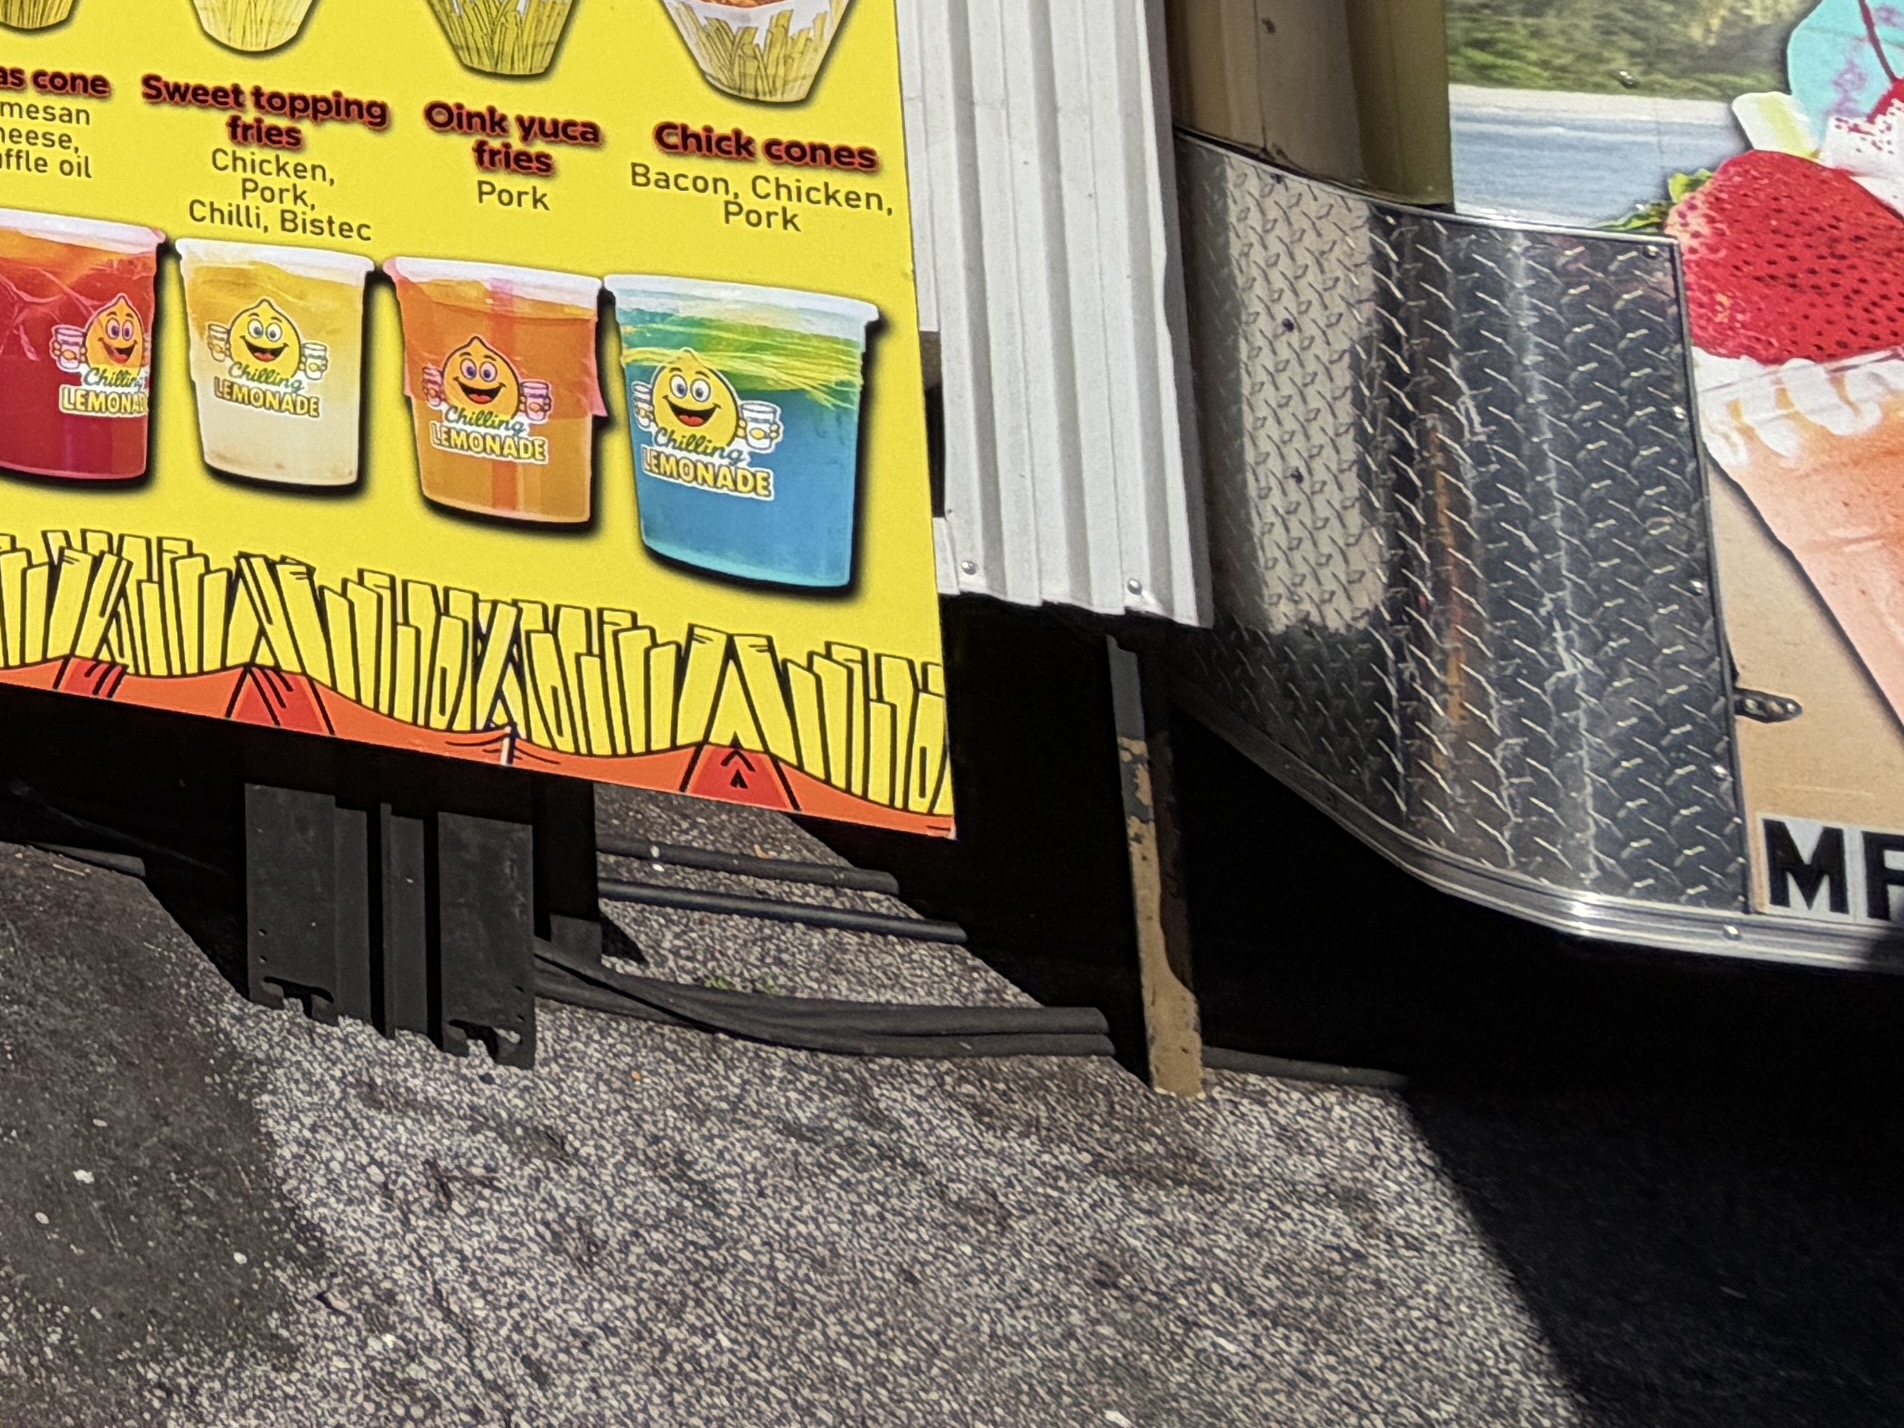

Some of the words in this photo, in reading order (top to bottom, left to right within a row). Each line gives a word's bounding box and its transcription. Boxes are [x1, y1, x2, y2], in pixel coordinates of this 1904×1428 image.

[32, 69, 111, 98] cone
[141, 73, 245, 108] Sweet
[252, 85, 389, 128] topping
[226, 116, 303, 149] fries
[424, 99, 509, 136] Oink
[516, 113, 602, 145] yuca
[472, 141, 554, 175] fries
[653, 121, 755, 160] Chick
[763, 136, 879, 171] cones
[59, 156, 92, 179] oil
[212, 148, 336, 186] Chicken,
[241, 178, 316, 210] Pork,
[477, 180, 550, 211] Pork
[630, 162, 740, 200] Bacon,
[751, 174, 894, 217] Chicken,
[188, 199, 269, 233] Chilli,
[280, 210, 372, 242] Bistec
[724, 200, 801, 232] Pork
[228, 360, 305, 393] Chilling
[213, 376, 320, 418] LEMONADE
[444, 405, 525, 435] Chilling
[431, 422, 547, 462] LEMONADE
[654, 428, 744, 464] Chilling
[642, 446, 770, 497] LEMONADE
